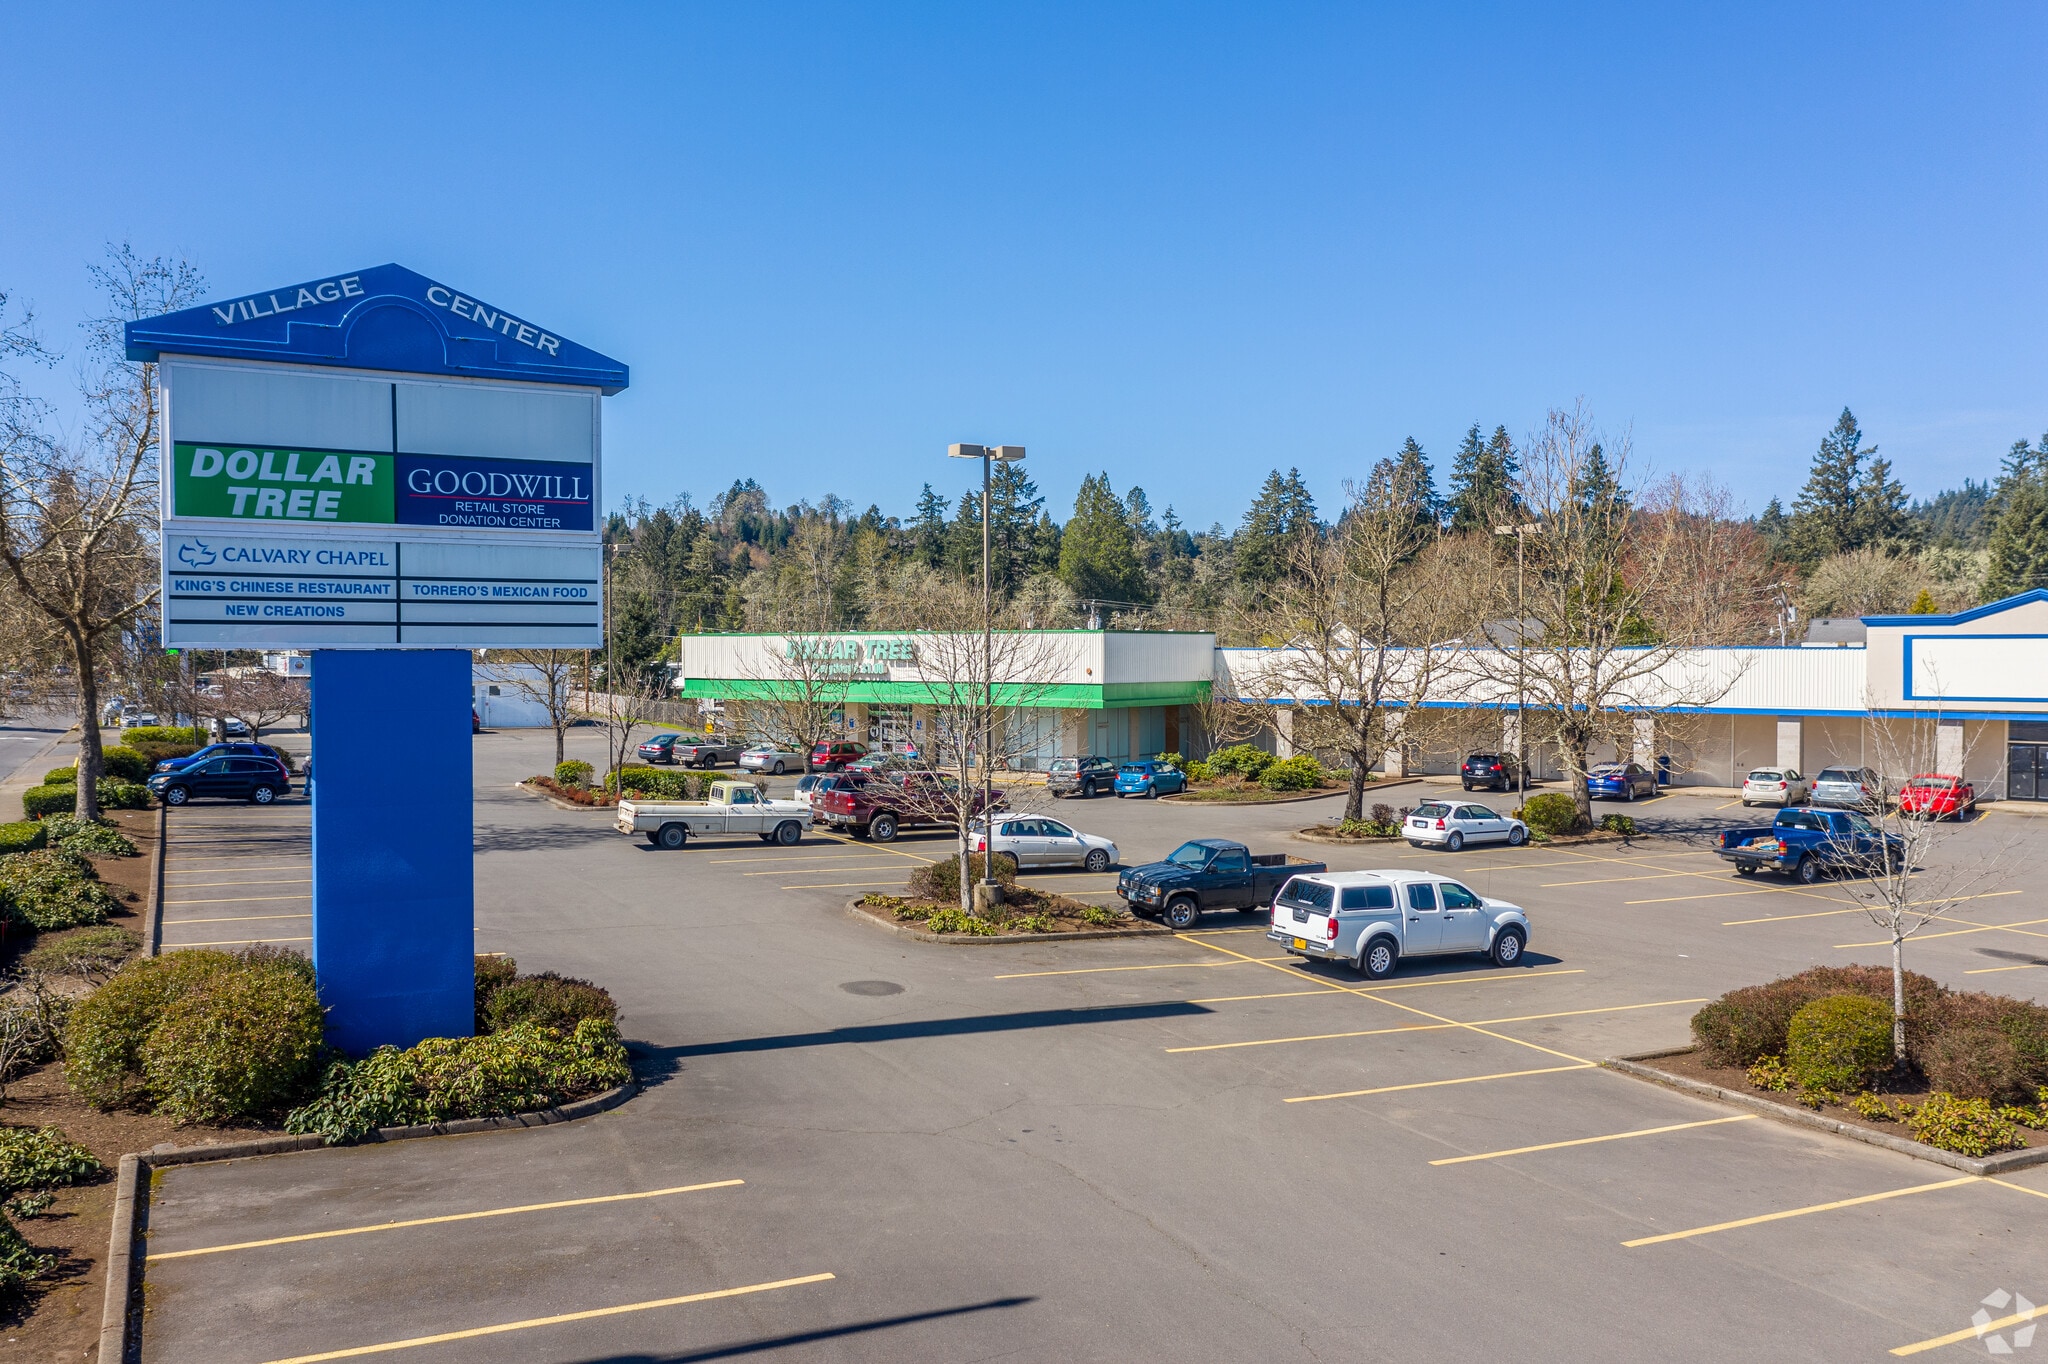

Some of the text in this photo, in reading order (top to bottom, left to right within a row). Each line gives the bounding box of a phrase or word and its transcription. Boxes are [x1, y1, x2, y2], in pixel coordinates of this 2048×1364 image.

[212, 276, 561, 357] VILLAGE CENTER
[190, 448, 376, 485] DOLLAR
[408, 468, 589, 500] GOODWILL
[227, 486, 342, 519] TREE
[455, 501, 545, 515] RETAIL STORE
[439, 514, 560, 528] DONATION CENTER
[222, 547, 389, 566] CALVARY CHAPEL
[175, 579, 391, 595] KING'S CHINESE RESTAURANT
[413, 584, 588, 598] TORRERO'S MEXICAN FOOD
[226, 604, 345, 617] NEW CREATIONS
[863, 639, 914, 660] TREE
